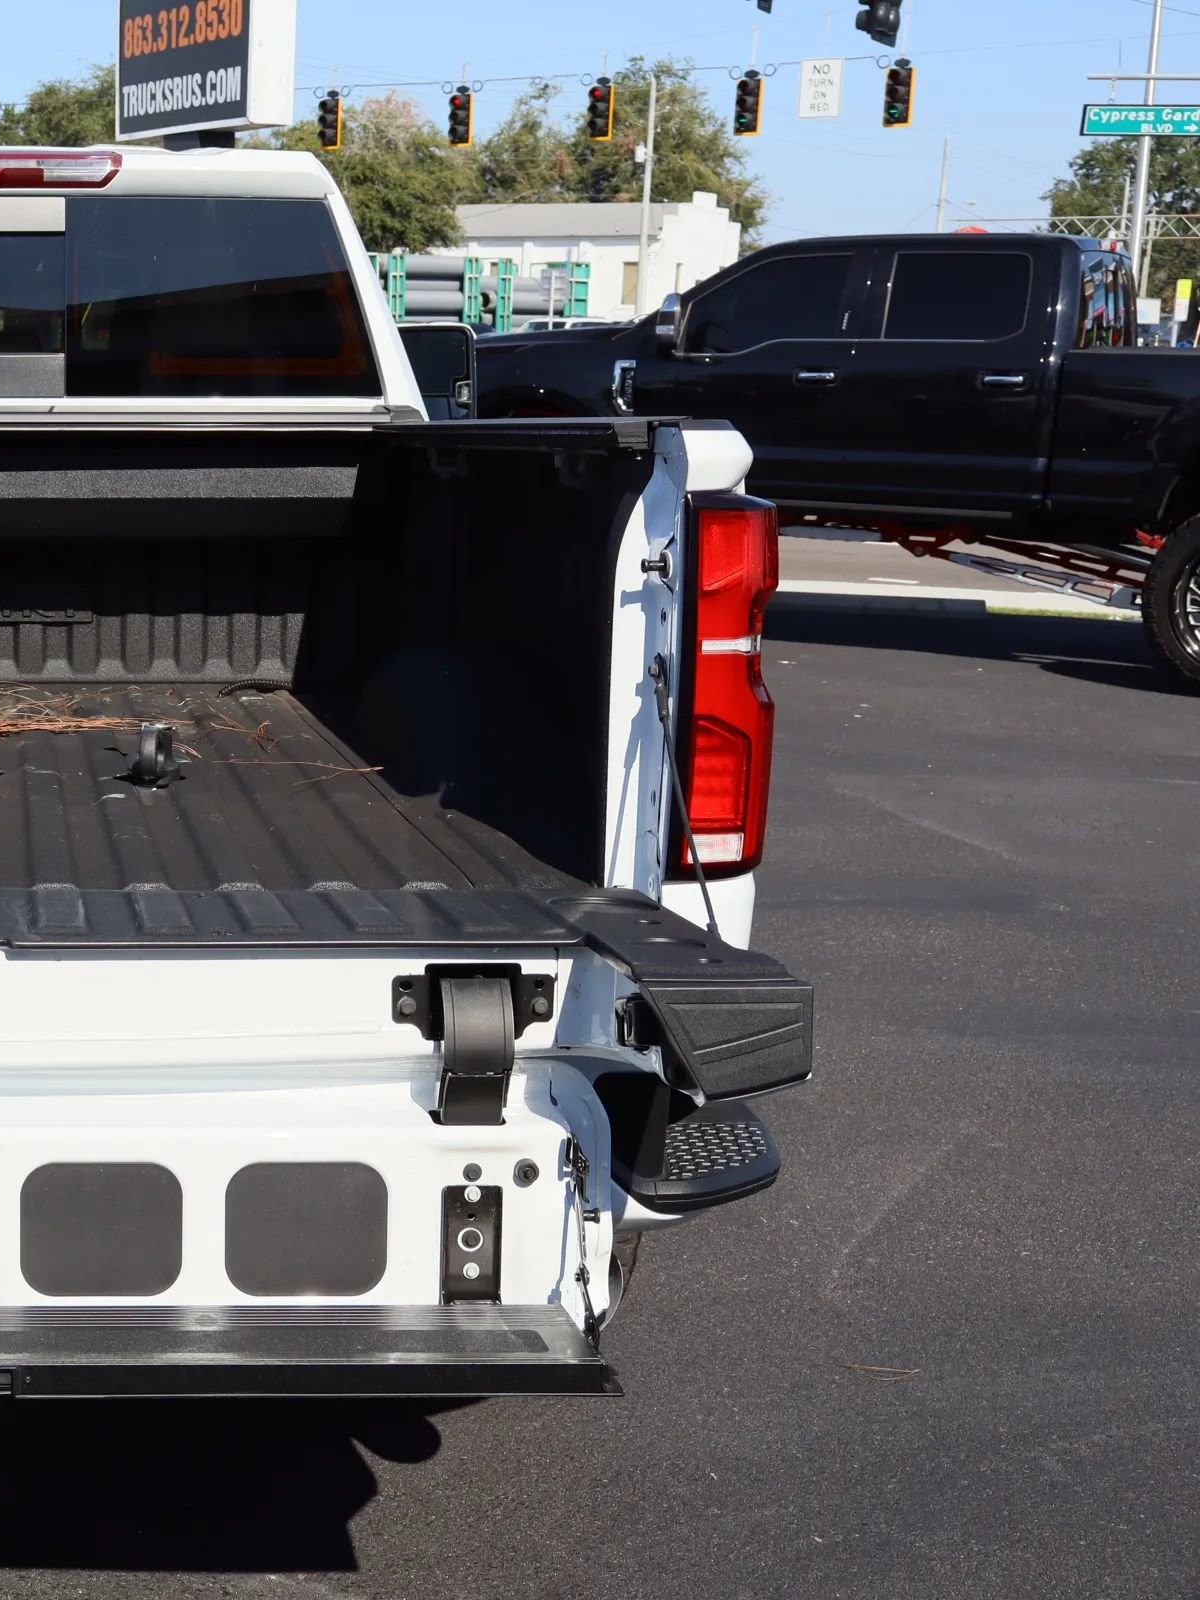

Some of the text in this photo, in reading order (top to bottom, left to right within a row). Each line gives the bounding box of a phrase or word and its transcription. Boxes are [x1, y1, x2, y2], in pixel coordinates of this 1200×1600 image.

[123, 0, 243, 58] 863.312.8530
[813, 63, 831, 75] NO
[808, 78, 834, 88] TURN
[122, 66, 242, 118] TRUCKSRUS.COM
[813, 91, 827, 100] ON
[810, 102, 829, 112] RED
[1089, 108, 1156, 123] Cypress
[1141, 123, 1174, 133] BLVD
